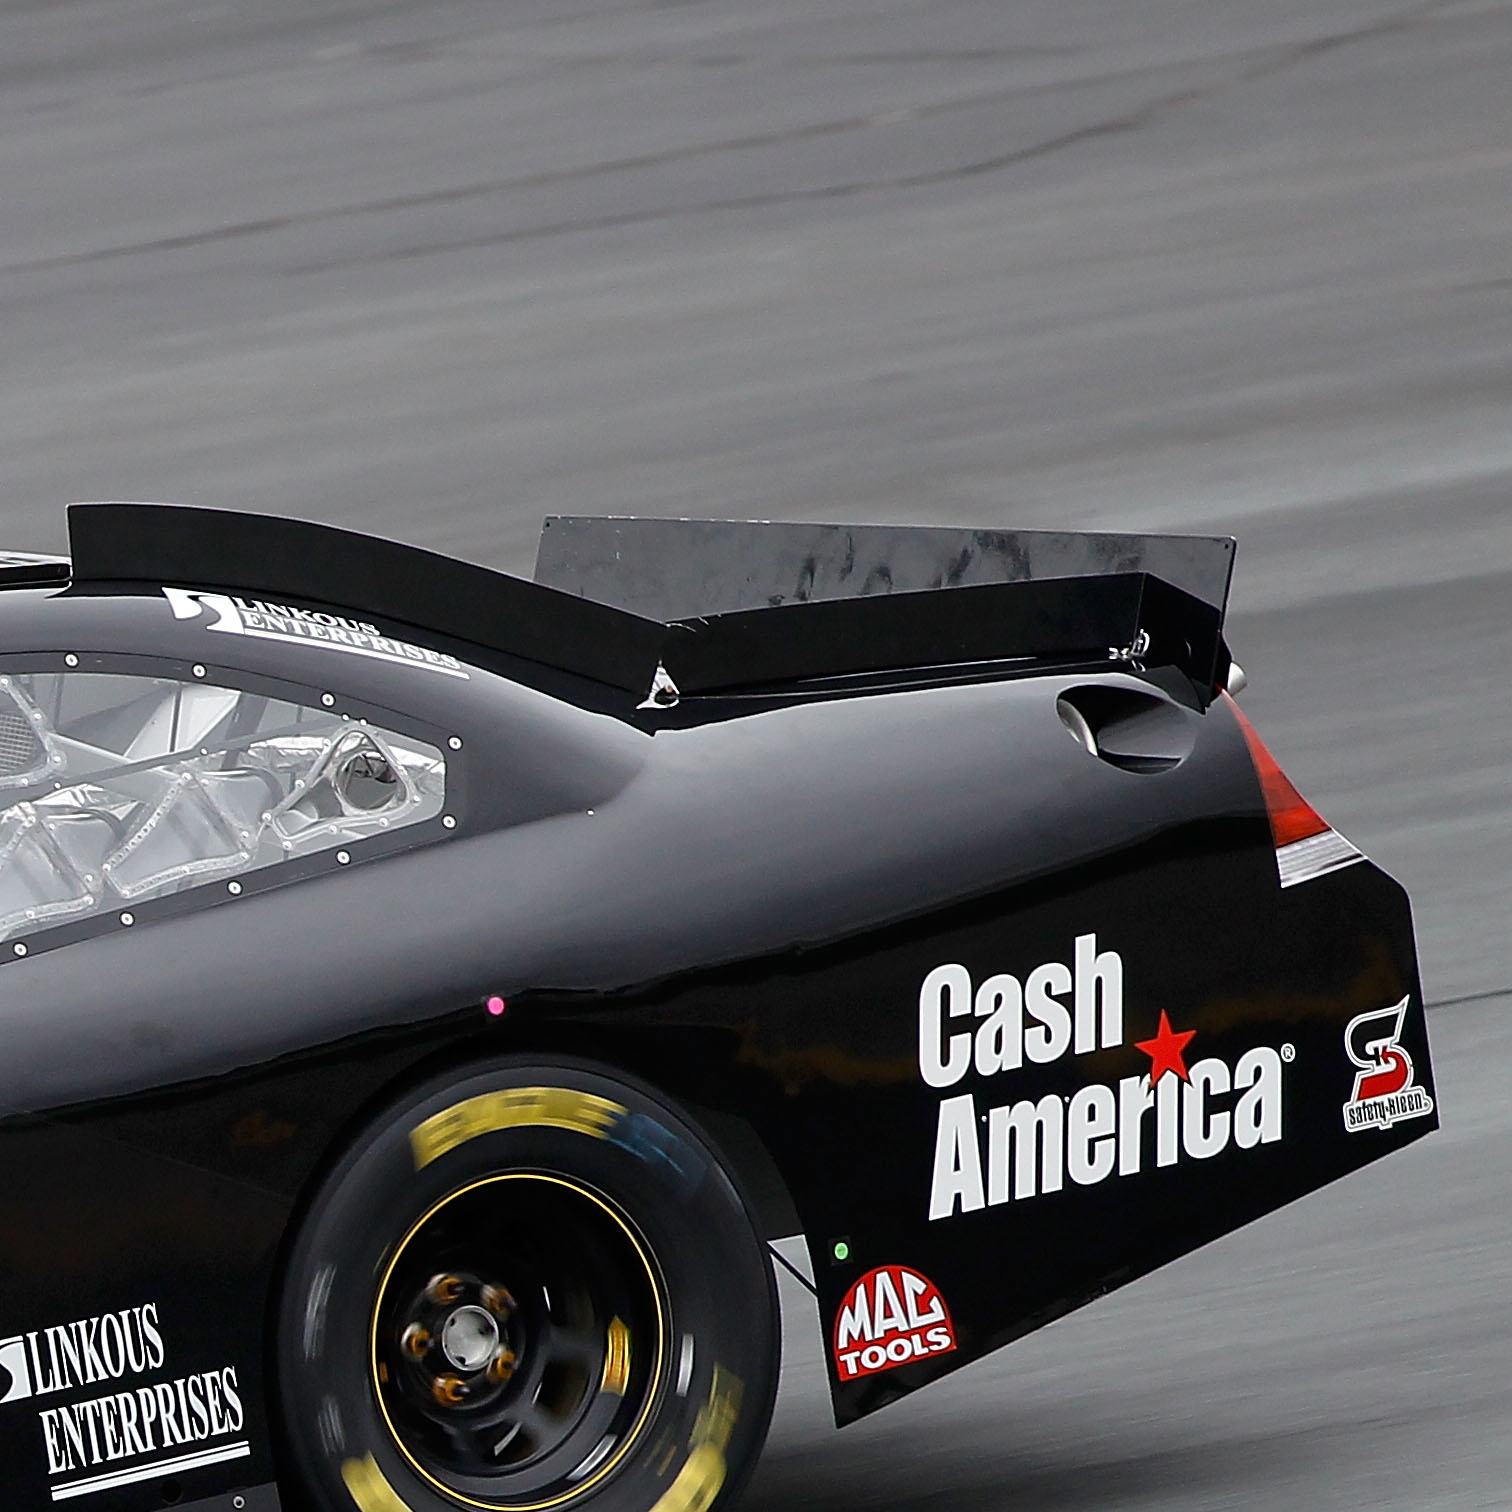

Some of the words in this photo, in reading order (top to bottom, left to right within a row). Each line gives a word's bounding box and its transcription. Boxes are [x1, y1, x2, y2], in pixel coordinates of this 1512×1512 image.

[233, 596, 381, 637] LINKOUS
[242, 611, 462, 670] ENTERPRISES
[919, 932, 1123, 1089] Cash
[928, 1045, 1283, 1221] America
[26, 1302, 165, 1396] LINKOUS
[838, 1271, 946, 1349] MAC
[839, 1327, 951, 1375] TOOLS
[38, 1365, 244, 1475] ENTERPRISES
